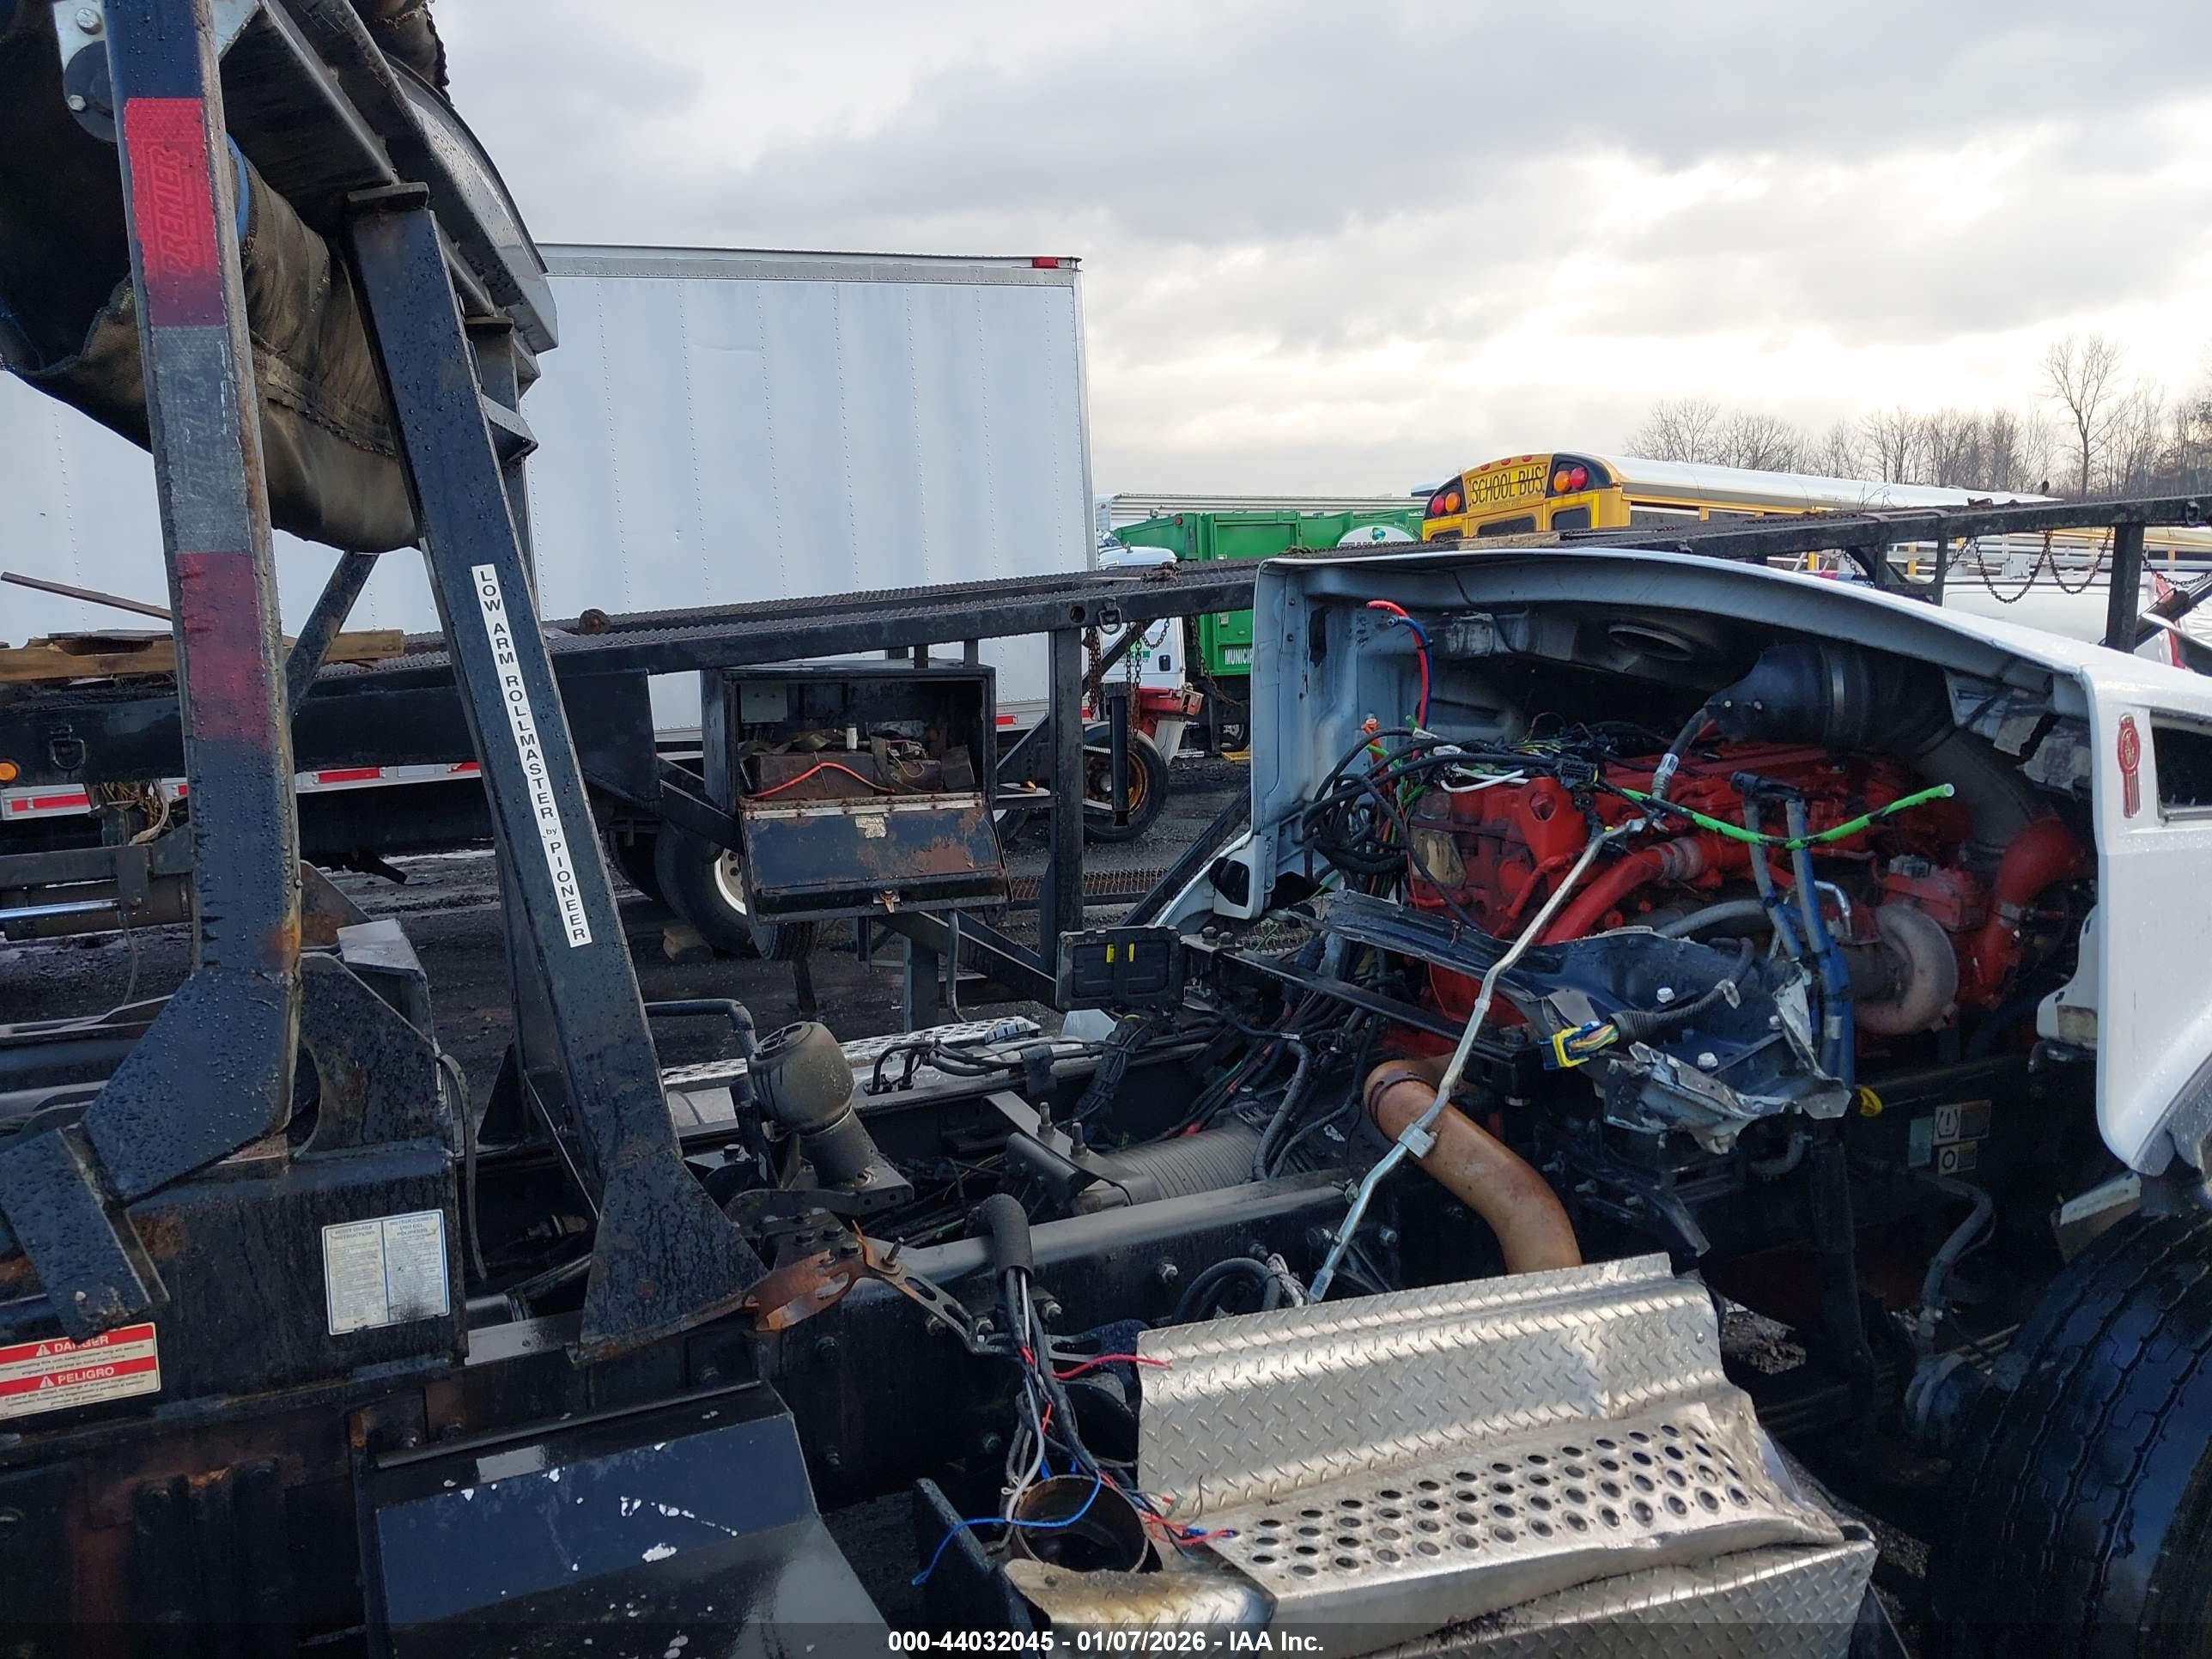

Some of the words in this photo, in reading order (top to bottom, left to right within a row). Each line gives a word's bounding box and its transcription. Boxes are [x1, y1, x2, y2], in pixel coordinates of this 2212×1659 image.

[149, 146, 191, 276] PREMIER
[1471, 473, 1515, 503] SCHOOL
[1518, 465, 1543, 495] BUS
[480, 571, 501, 611] LOW
[494, 623, 514, 665] ARM
[506, 675, 554, 819] ROLLMASTER
[550, 842, 586, 940] PIONEER
[58, 1366, 114, 1384] PELIGRO
